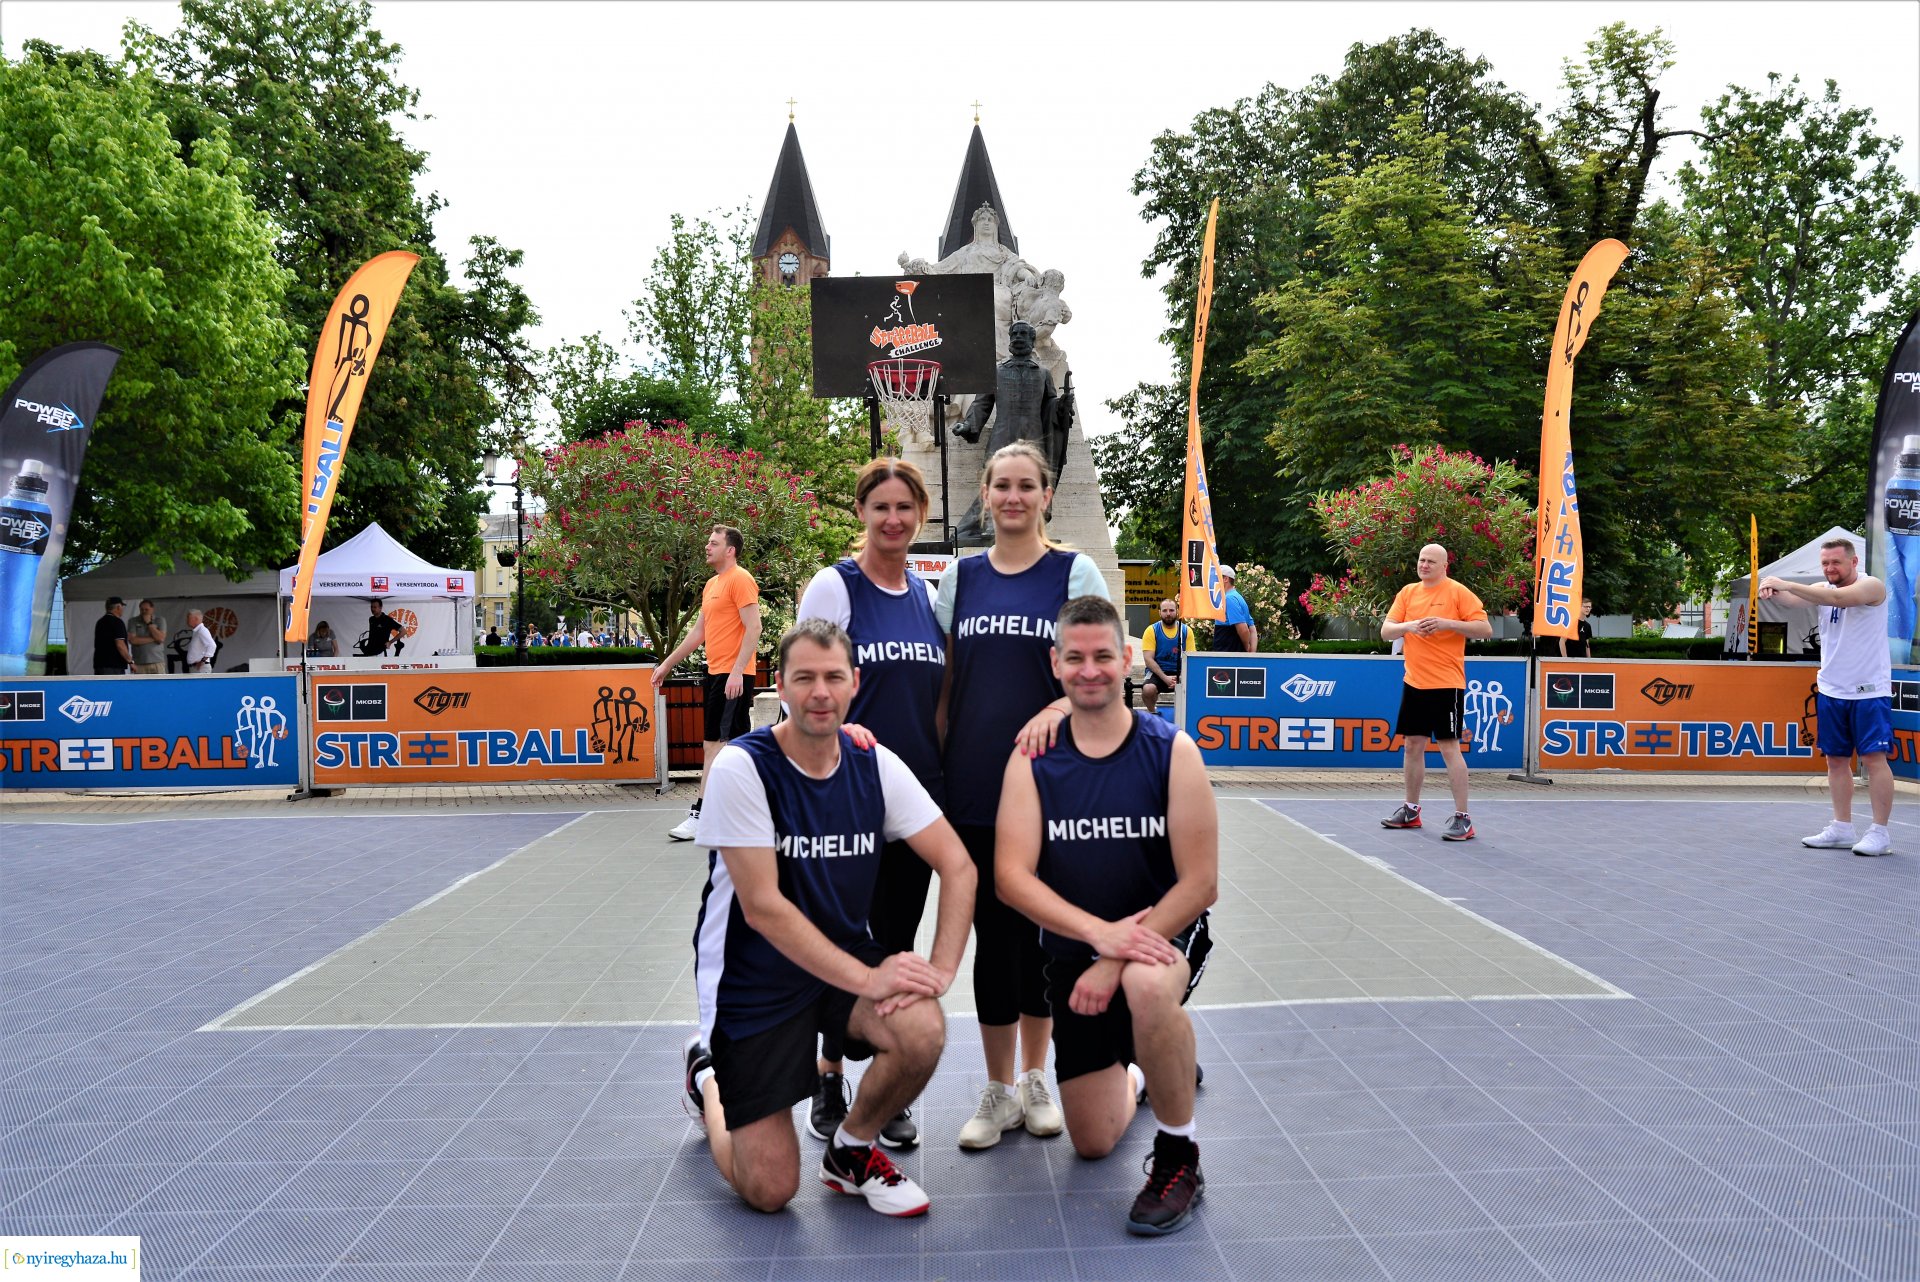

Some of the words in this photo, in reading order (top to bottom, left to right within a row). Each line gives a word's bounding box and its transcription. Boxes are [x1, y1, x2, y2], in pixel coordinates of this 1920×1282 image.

[894, 338, 940, 356] CHALLENGE
[1894, 373, 1920, 384] POW
[15, 399, 74, 421] POWER
[37, 413, 73, 431] ADE
[1884, 497, 1920, 510] POWE
[0, 517, 43, 531] OWER
[10, 527, 41, 540] ADE
[958, 615, 1057, 641] MICHELIN
[1293, 680, 1337, 696] TOTI
[1653, 684, 1695, 700] TOTI
[427, 691, 471, 708] TOTI
[70, 701, 113, 717] TOTI
[1196, 715, 1470, 753] STREETB
[0, 735, 248, 772] TREETBALL
[1048, 815, 1166, 841] MICHELIN
[775, 832, 875, 859] MICHELIN
